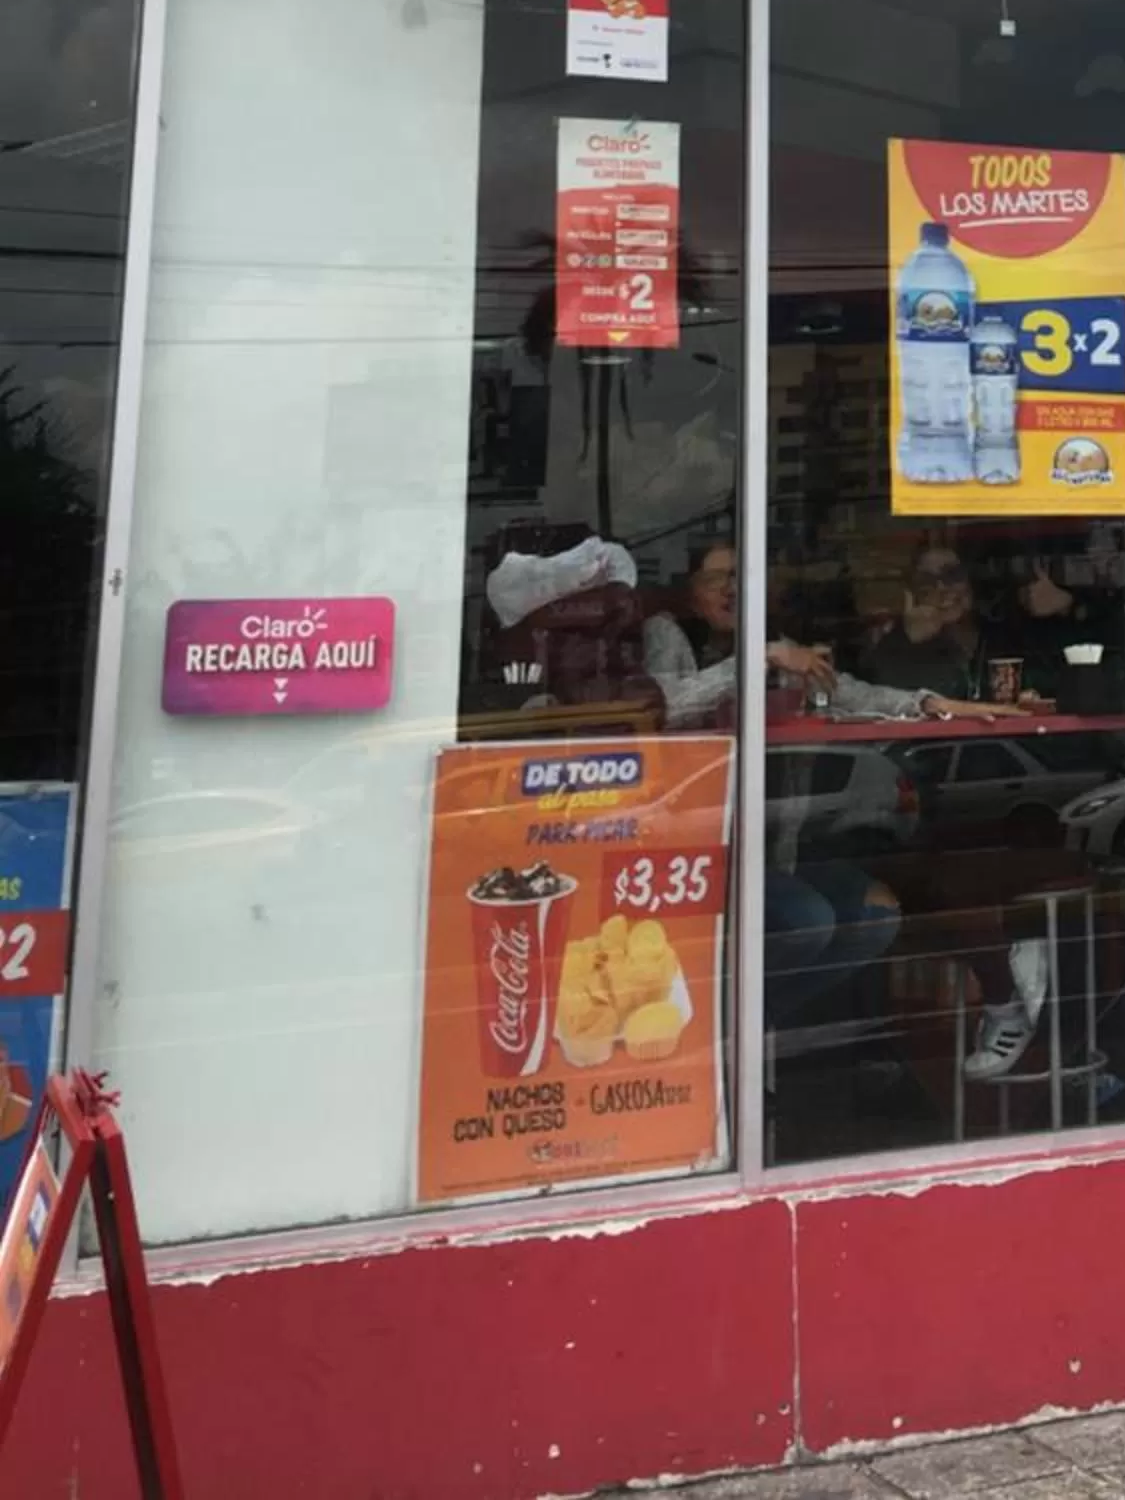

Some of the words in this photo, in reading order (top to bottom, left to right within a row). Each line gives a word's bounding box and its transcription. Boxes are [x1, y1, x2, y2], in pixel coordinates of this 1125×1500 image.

[969, 152, 1052, 189] TODOS
[939, 193, 986, 217] LOS
[991, 189, 1090, 214] MARTES
[241, 612, 320, 638] Claro
[186, 642, 305, 672] RECARGA
[315, 635, 377, 669] AQUÍ
[525, 762, 562, 789] DE
[566, 757, 638, 784] TODO
[613, 855, 712, 913] $3,35
[486, 1081, 566, 1113] NACHOS
[589, 1080, 666, 1115] GASEOSA
[453, 1114, 494, 1142] CON
[502, 1107, 567, 1141] QUESO
